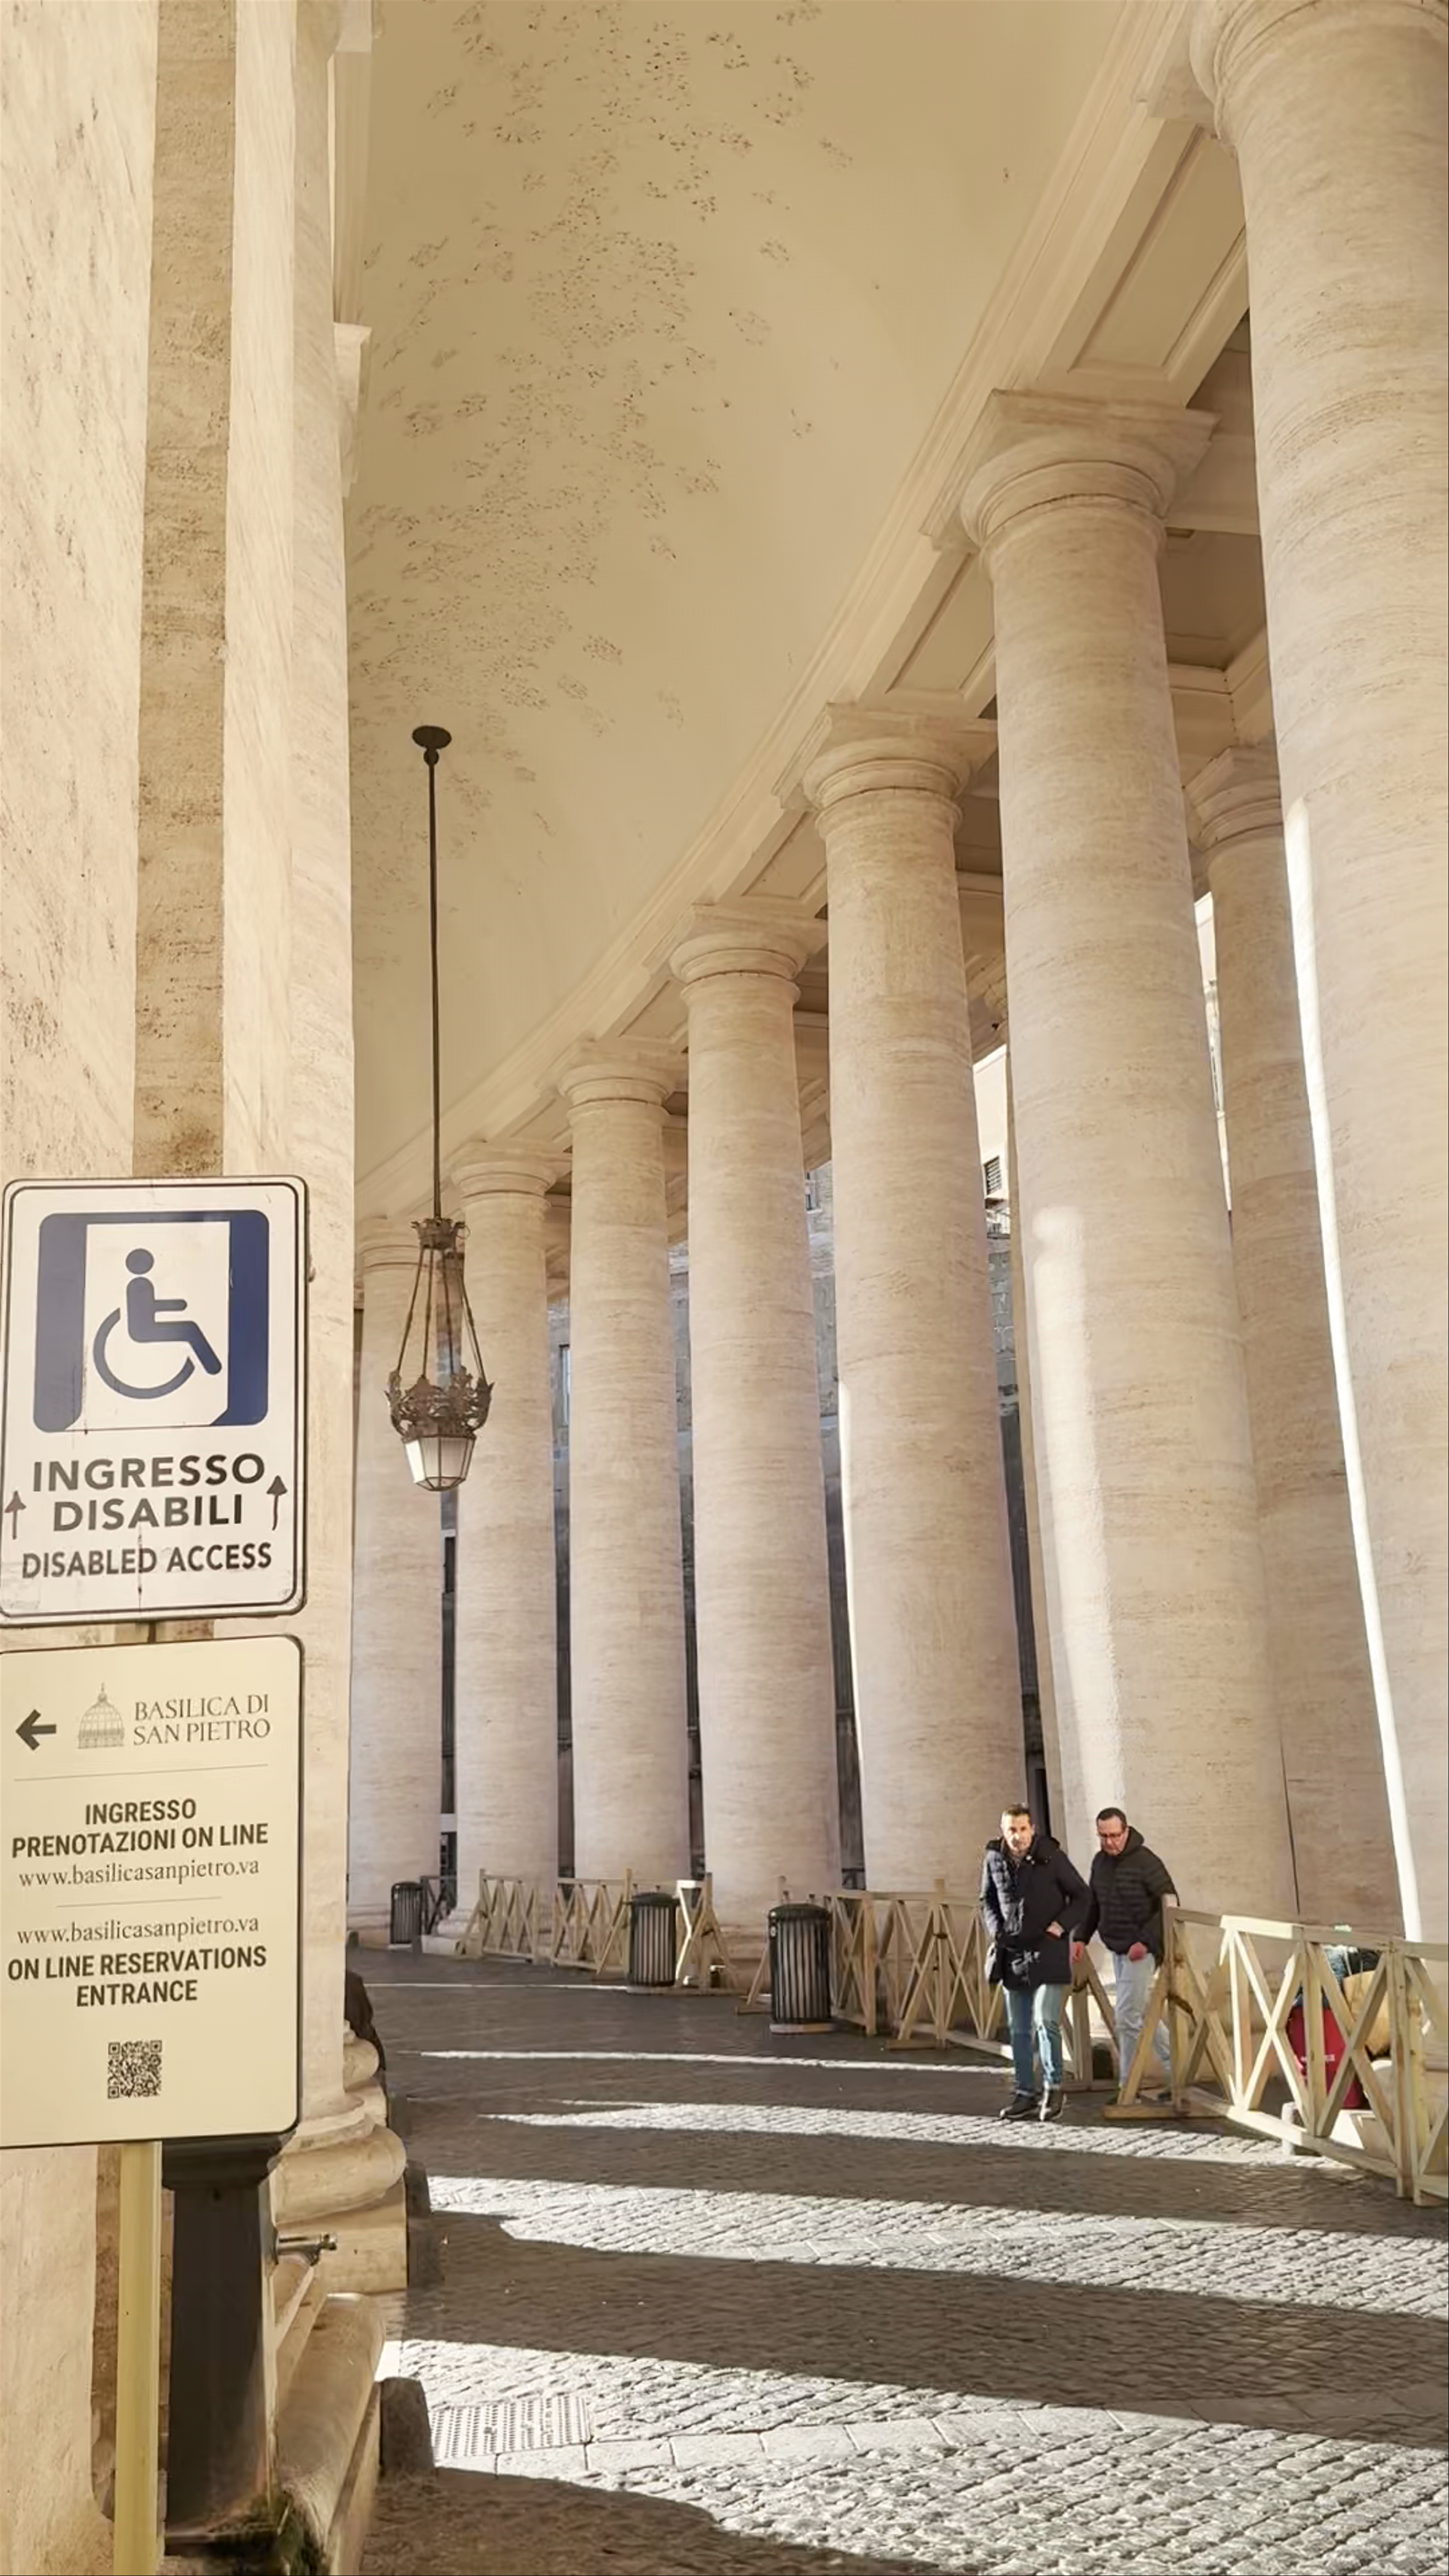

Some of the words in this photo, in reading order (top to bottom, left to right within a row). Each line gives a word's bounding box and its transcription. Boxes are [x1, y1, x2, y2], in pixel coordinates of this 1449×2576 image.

[34, 1453, 265, 1492] INGRESSO
[54, 1494, 242, 1531] DISABILI
[22, 1548, 157, 1578] DISABLED
[167, 1543, 271, 1572] ACCESS
[135, 1697, 240, 1721] BASILICA
[248, 1694, 268, 1713] DI
[134, 1724, 179, 1745] SAN
[187, 1719, 270, 1742] PIETRO
[86, 1799, 196, 1825] INGRESSO
[12, 1829, 175, 1858] PRENOTAZIONI
[182, 1827, 213, 1848] ON
[220, 1823, 268, 1846] LINE
[19, 1859, 258, 1886] www.basilicasanpietro.va
[17, 1917, 258, 1944] www.basilicasanpietro.va
[8, 1958, 39, 1980] ON
[46, 1955, 94, 1978] LINE
[101, 1946, 266, 1975] RESERVATIONS
[77, 1980, 197, 2007] ENTRANCE
